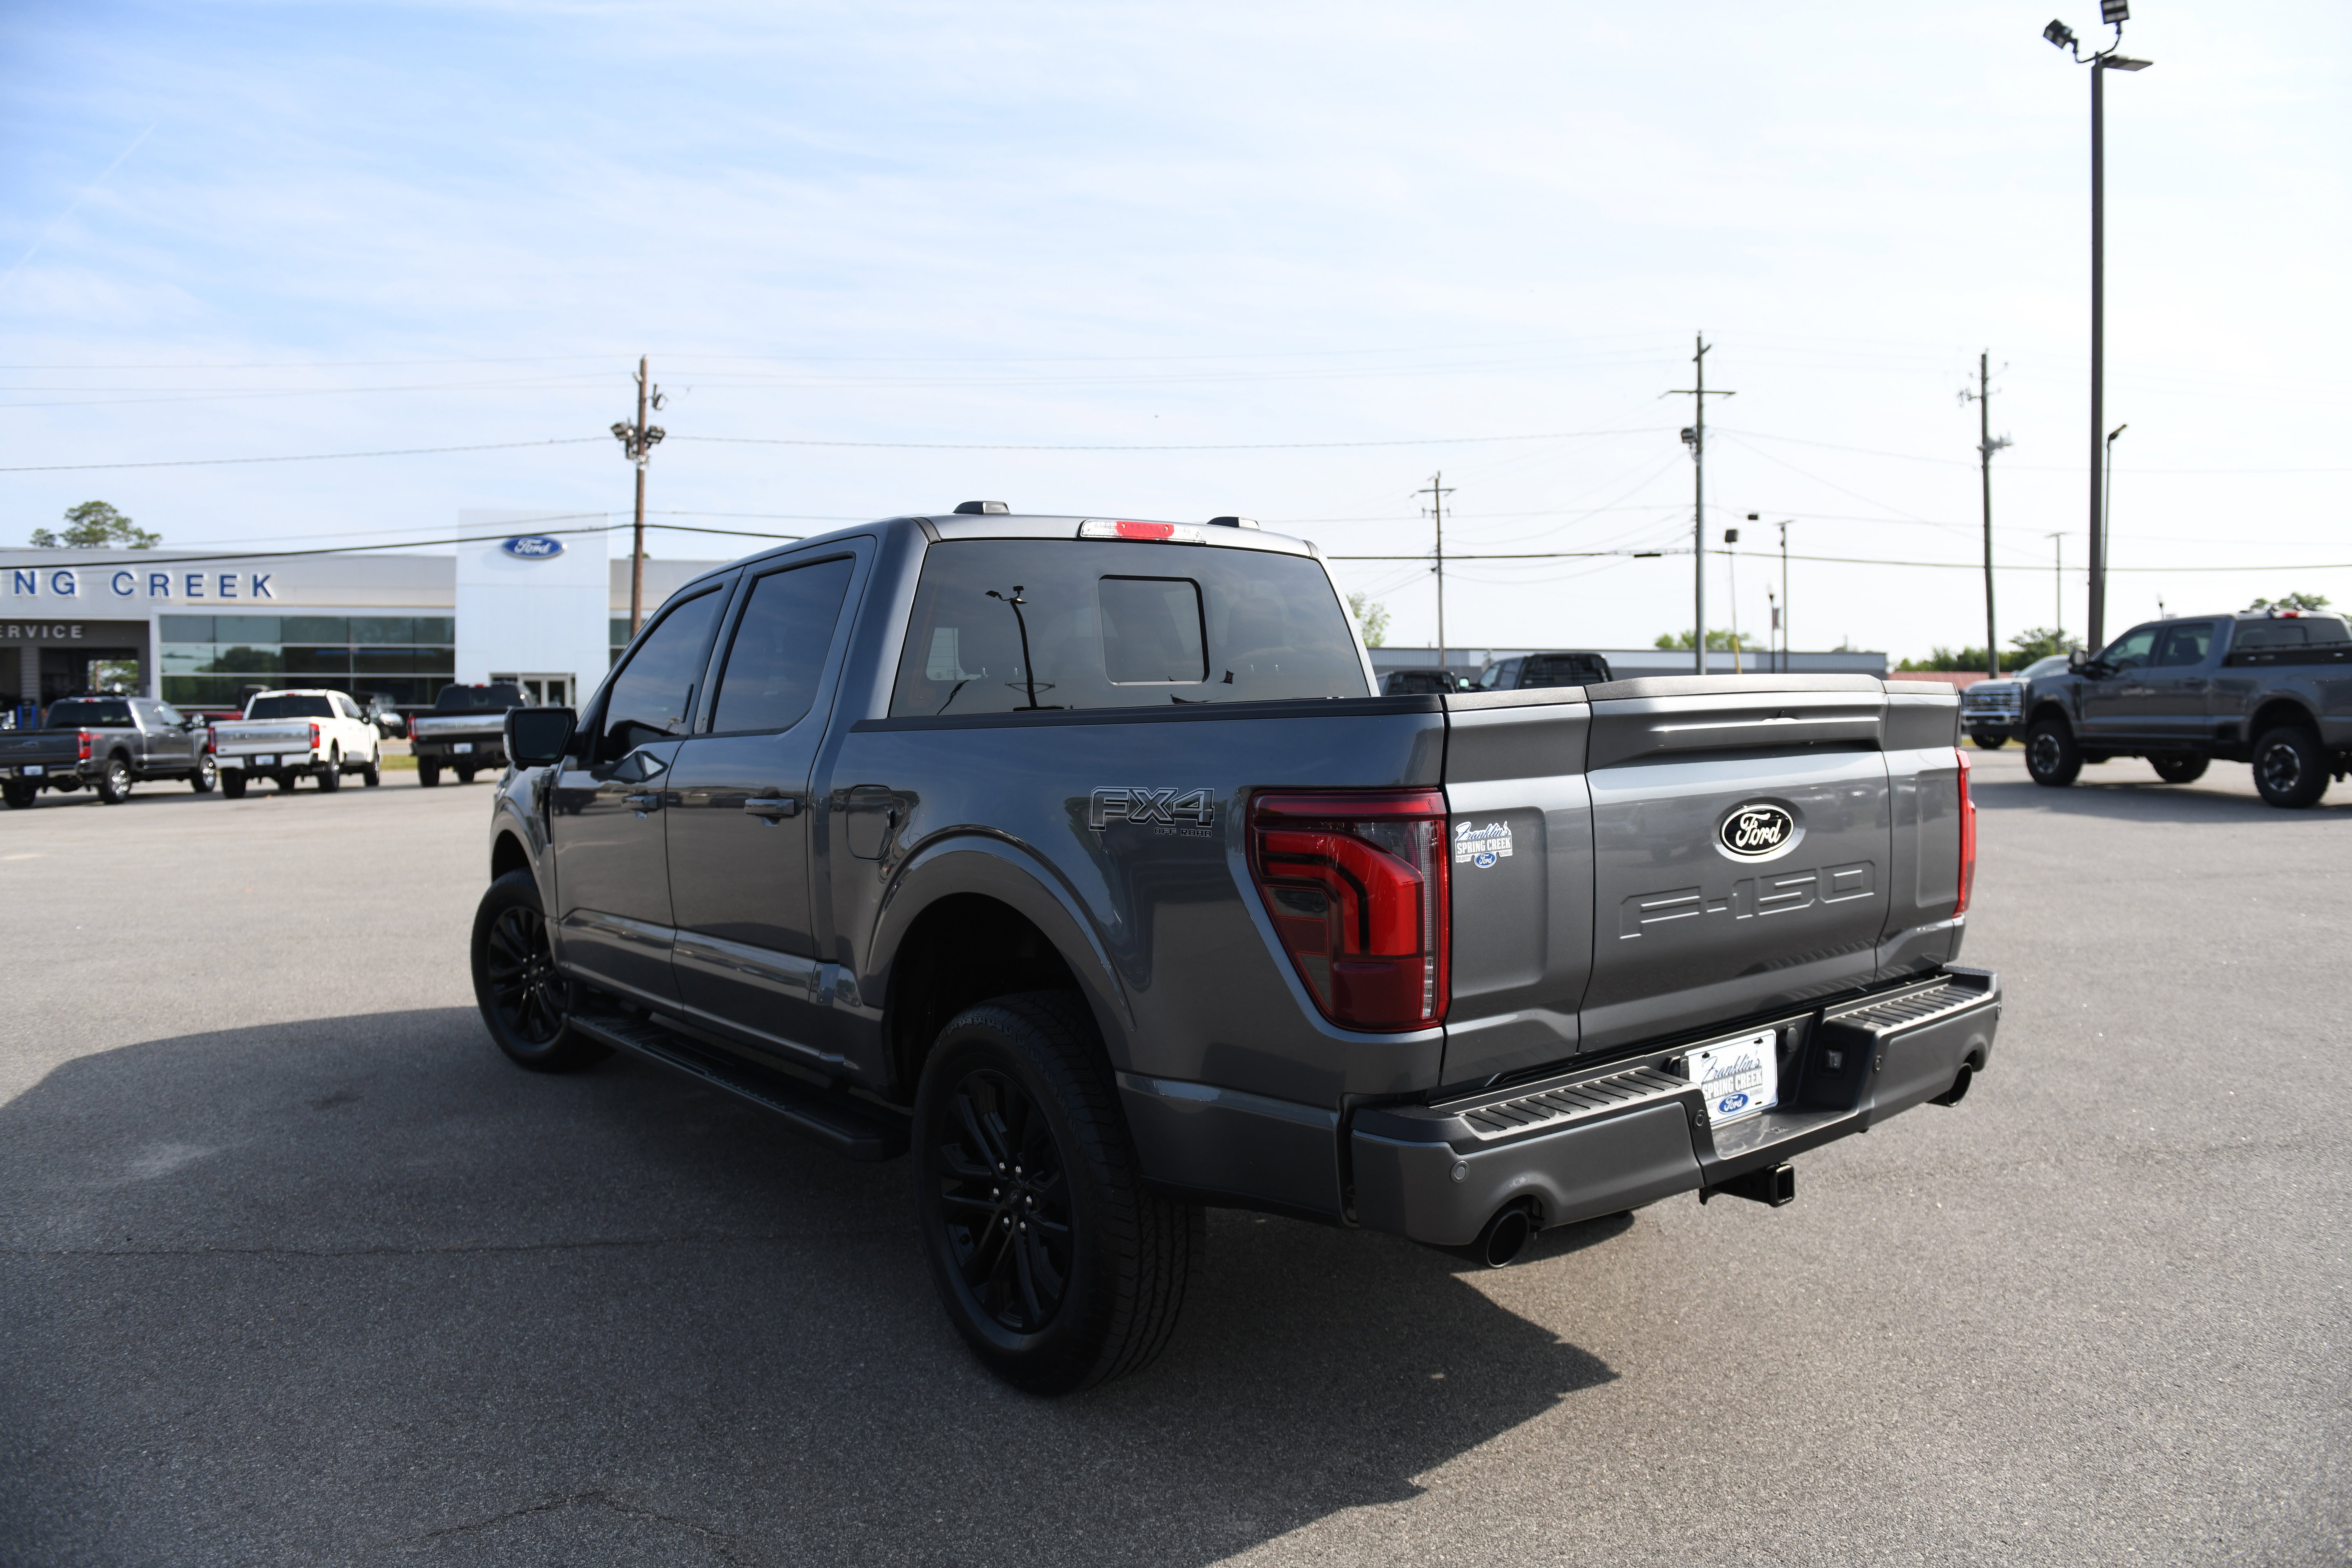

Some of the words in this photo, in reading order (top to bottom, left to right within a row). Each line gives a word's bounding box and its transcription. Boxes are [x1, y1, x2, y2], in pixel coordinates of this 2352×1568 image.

[514, 538, 551, 554] Ford
[112, 571, 273, 598] CREEK
[1089, 786, 1215, 831] FX4
[1180, 829, 1212, 837] ROAD
[1456, 821, 1510, 842] Franklin's
[1735, 813, 1782, 847] Ford
[1457, 840, 1486, 854] SPRING
[1487, 837, 1511, 851] CREEK
[1479, 854, 1492, 864] Ford
[1620, 860, 1875, 939] F-150
[1702, 1049, 1761, 1084] Franklin's
[1702, 1076, 1734, 1101] SPRING
[1735, 1068, 1762, 1091] CREEK
[1750, 1087, 1764, 1096] GEORGIA
[1723, 1095, 1743, 1111] Ford
